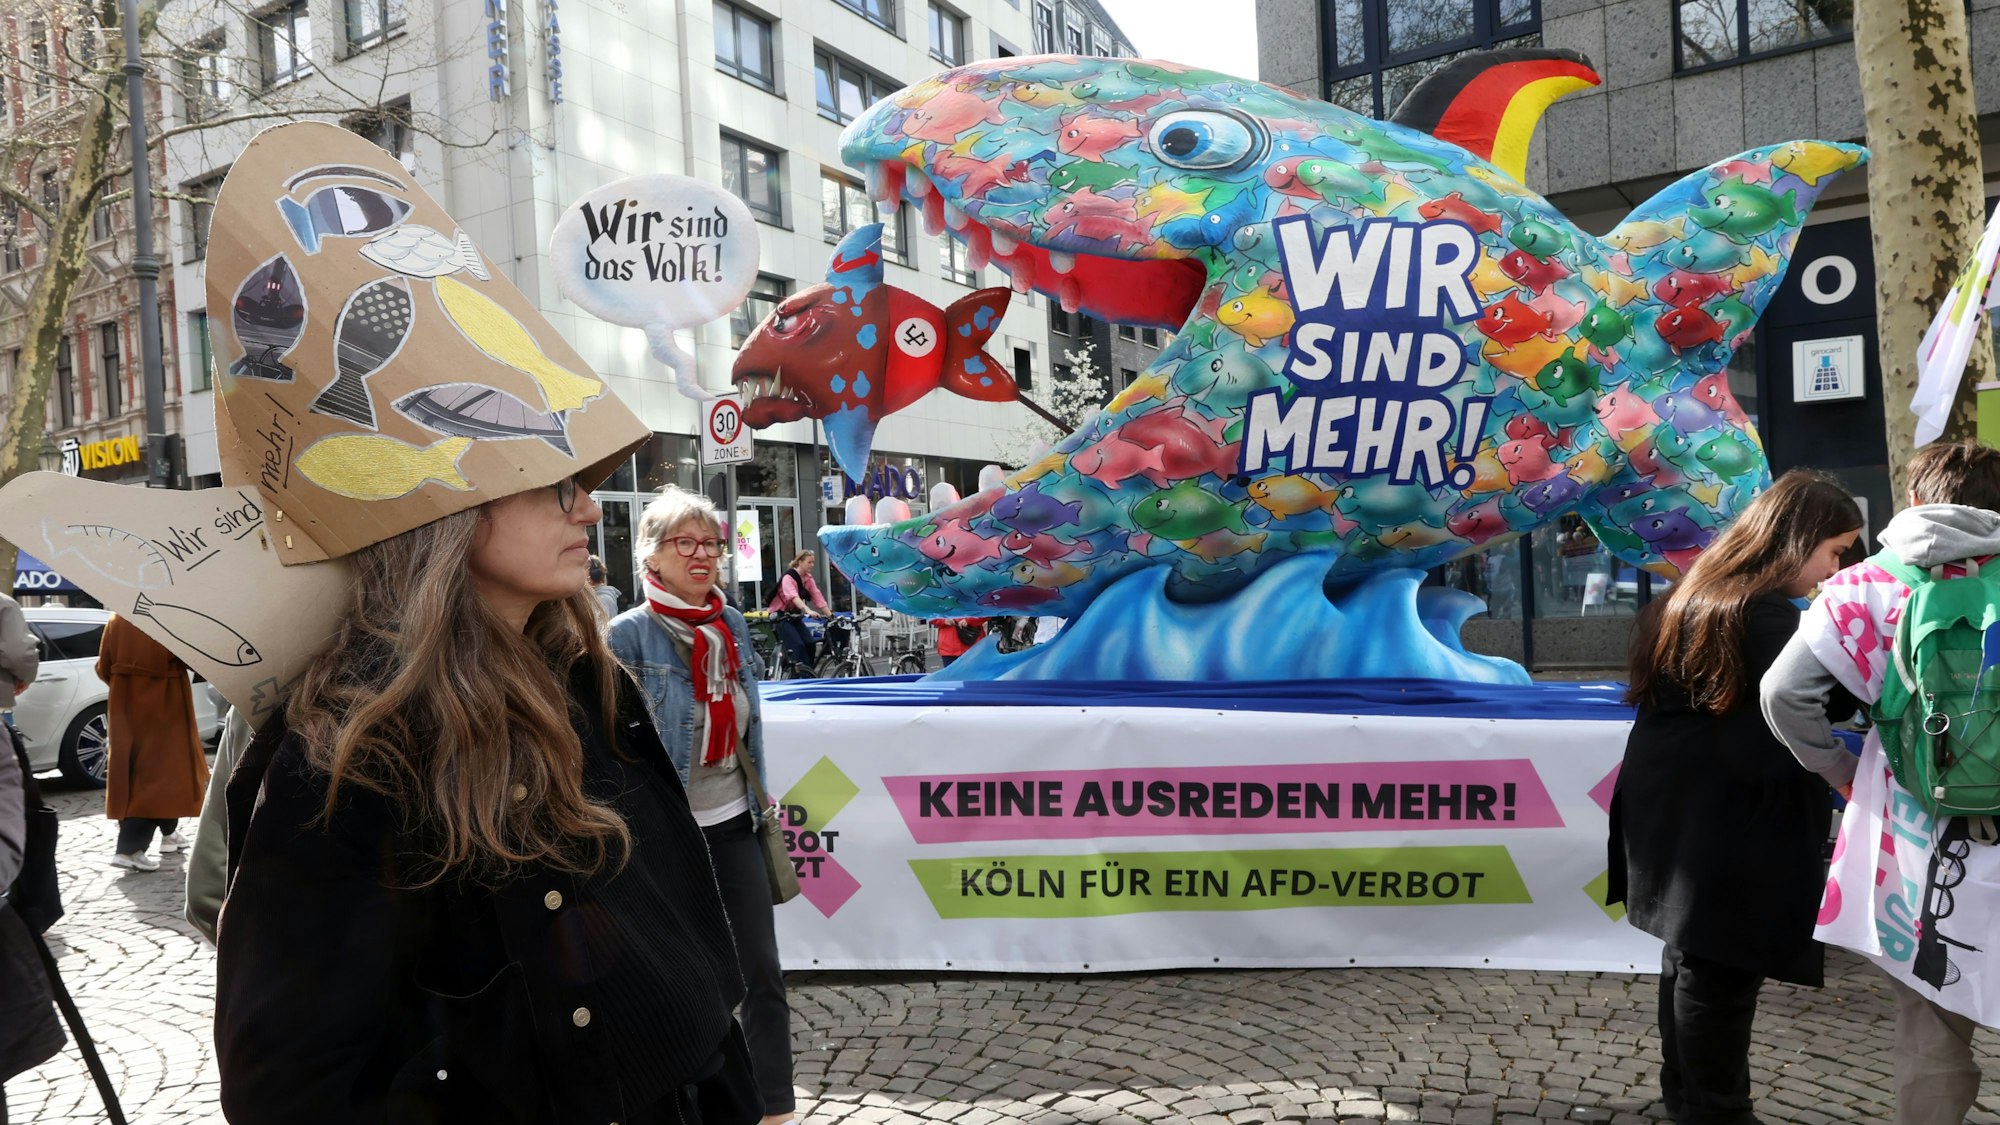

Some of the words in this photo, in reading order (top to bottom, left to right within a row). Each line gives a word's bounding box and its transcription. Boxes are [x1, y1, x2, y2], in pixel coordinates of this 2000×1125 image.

[579, 198, 665, 246] Wir
[668, 205, 729, 239] sind
[585, 243, 637, 282] das
[641, 242, 722, 283] Volk!
[1274, 217, 1482, 320] WIR
[1287, 320, 1463, 389] SIND
[261, 392, 302, 495] mehr!
[716, 411, 735, 432] 30
[1243, 391, 1488, 488] MEHR!
[80, 434, 140, 471] VISION
[714, 446, 739, 460] ZONE
[151, 526, 208, 562] Wir
[214, 490, 263, 535] sind
[919, 781, 1063, 818] KEINE
[1072, 780, 1340, 820] AUSREDEN
[1352, 782, 1517, 822] MEHR!
[961, 861, 1065, 899] KÖLN
[1080, 861, 1152, 899] FÜR
[1165, 869, 1229, 898] EIN
[1241, 869, 1485, 899] AFD-VERBOT
